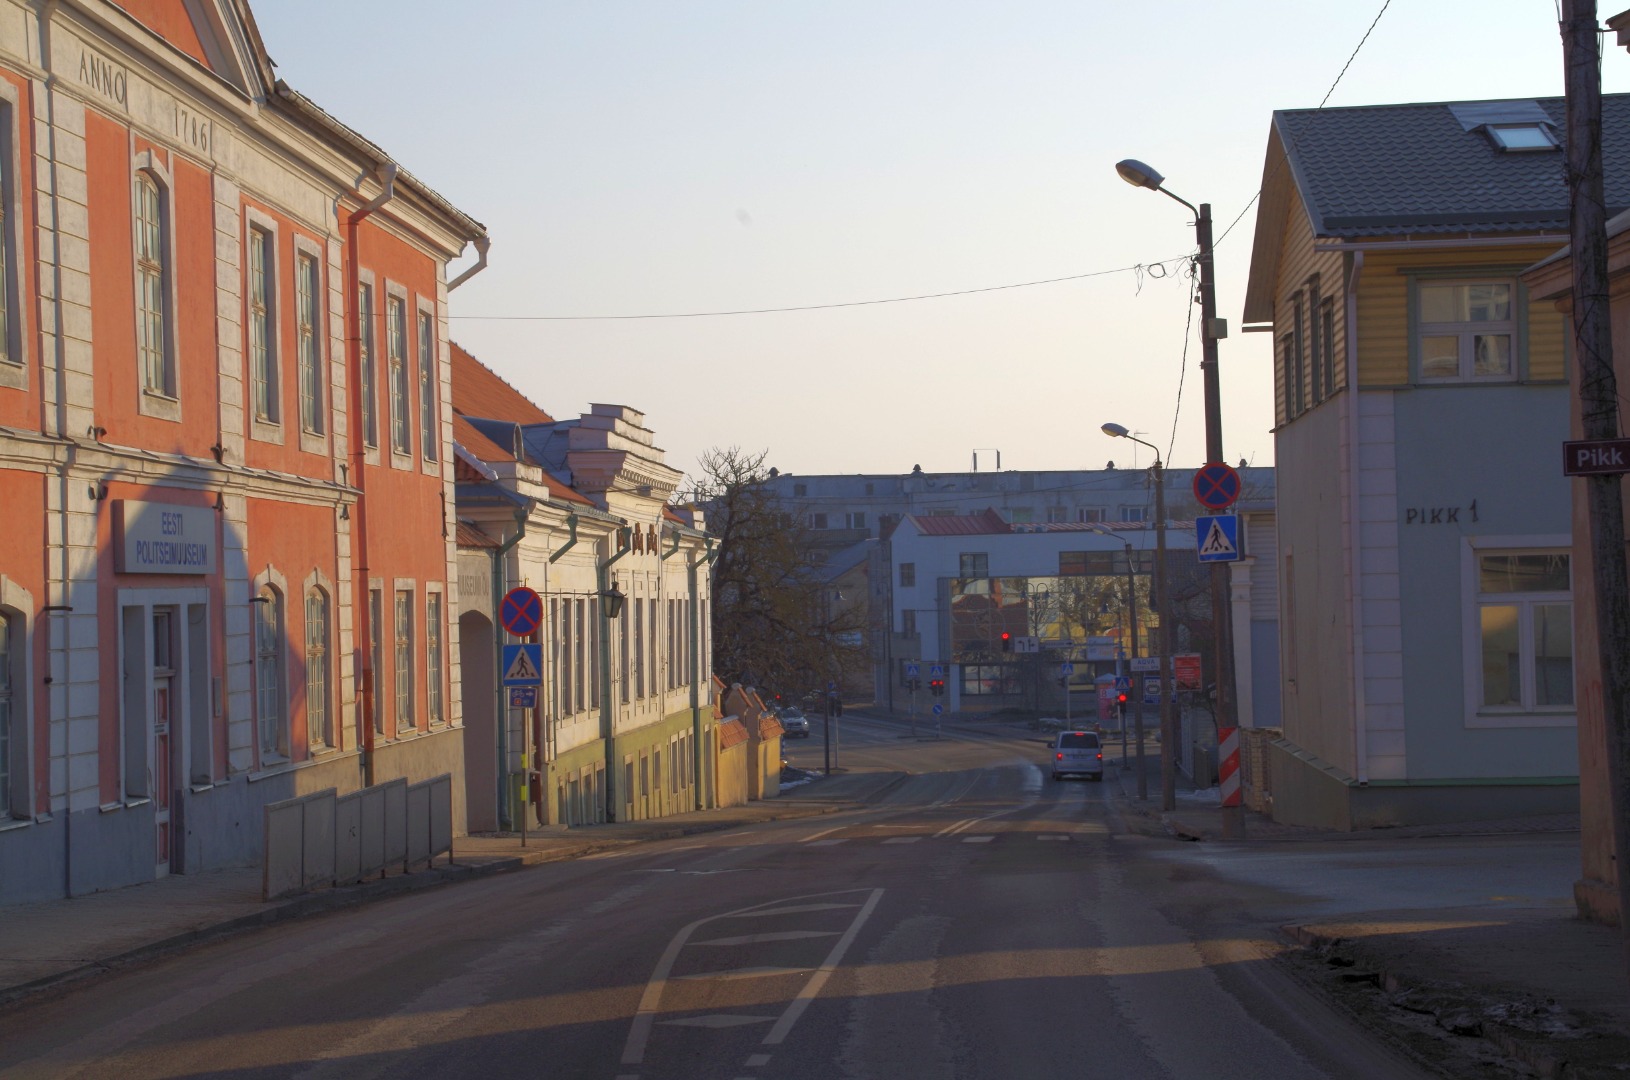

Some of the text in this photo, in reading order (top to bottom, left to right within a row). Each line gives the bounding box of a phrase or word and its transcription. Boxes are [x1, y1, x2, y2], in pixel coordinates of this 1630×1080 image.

[80, 48, 207, 151] ANNO 1786
[1577, 448, 1624, 466] Pikk
[162, 512, 183, 535] EESTI
[1406, 499, 1479, 524] PIKK 1
[137, 541, 207, 565] POLITSEIMUUSEUM
